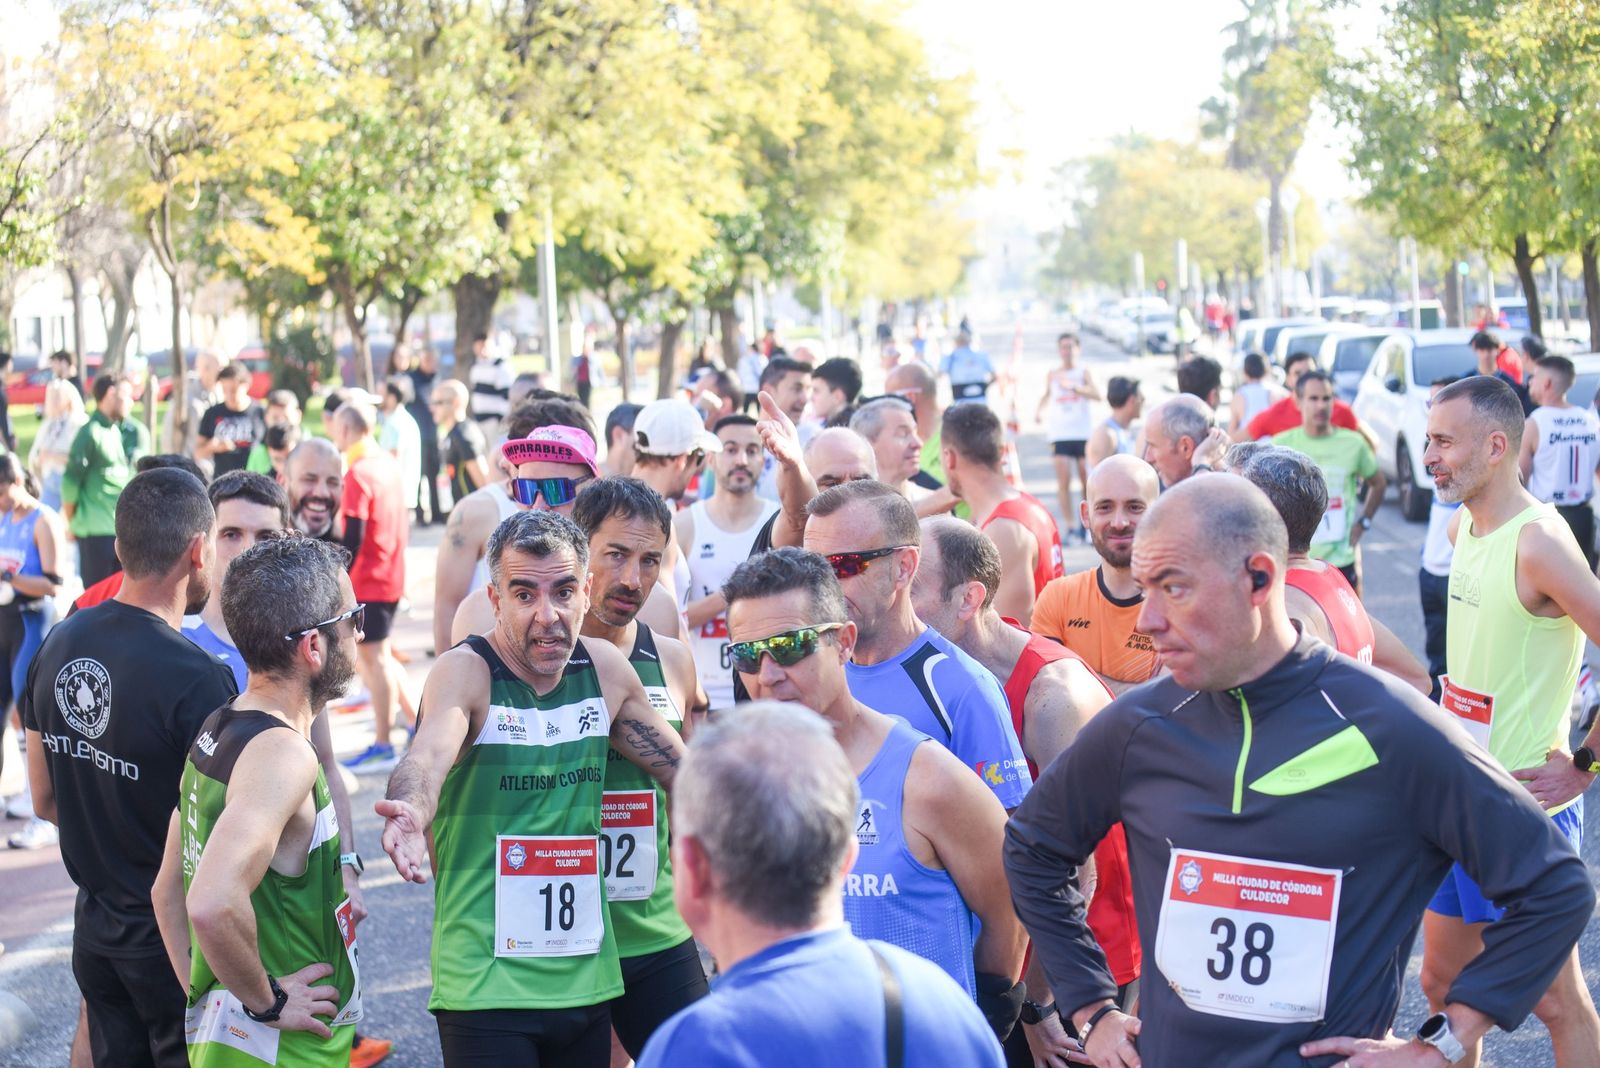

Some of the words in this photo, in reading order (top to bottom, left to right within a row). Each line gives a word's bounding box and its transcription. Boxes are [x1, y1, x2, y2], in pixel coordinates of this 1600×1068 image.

[505, 443, 573, 457] IMPARABLES
[1128, 633, 1152, 643] ATLETIS
[71, 661, 107, 683] ATLETISMO
[1006, 772, 1018, 781] de
[618, 803, 625, 811] DE
[626, 802, 648, 811] CÓRDOBA
[535, 849, 552, 858] MILLA
[553, 849, 570, 858] CIUDAD
[555, 858, 581, 868] CULDECOR
[841, 872, 900, 897] RRA
[1213, 872, 1236, 886] MILLA
[1236, 875, 1269, 890] CIUDAD
[1269, 879, 1282, 891] DE
[1282, 880, 1323, 897] CÓRDOBA
[1240, 888, 1290, 906] CULDECOR
[539, 882, 575, 932] 18
[1207, 917, 1275, 986] 38
[1225, 993, 1255, 1005] IMDECO
